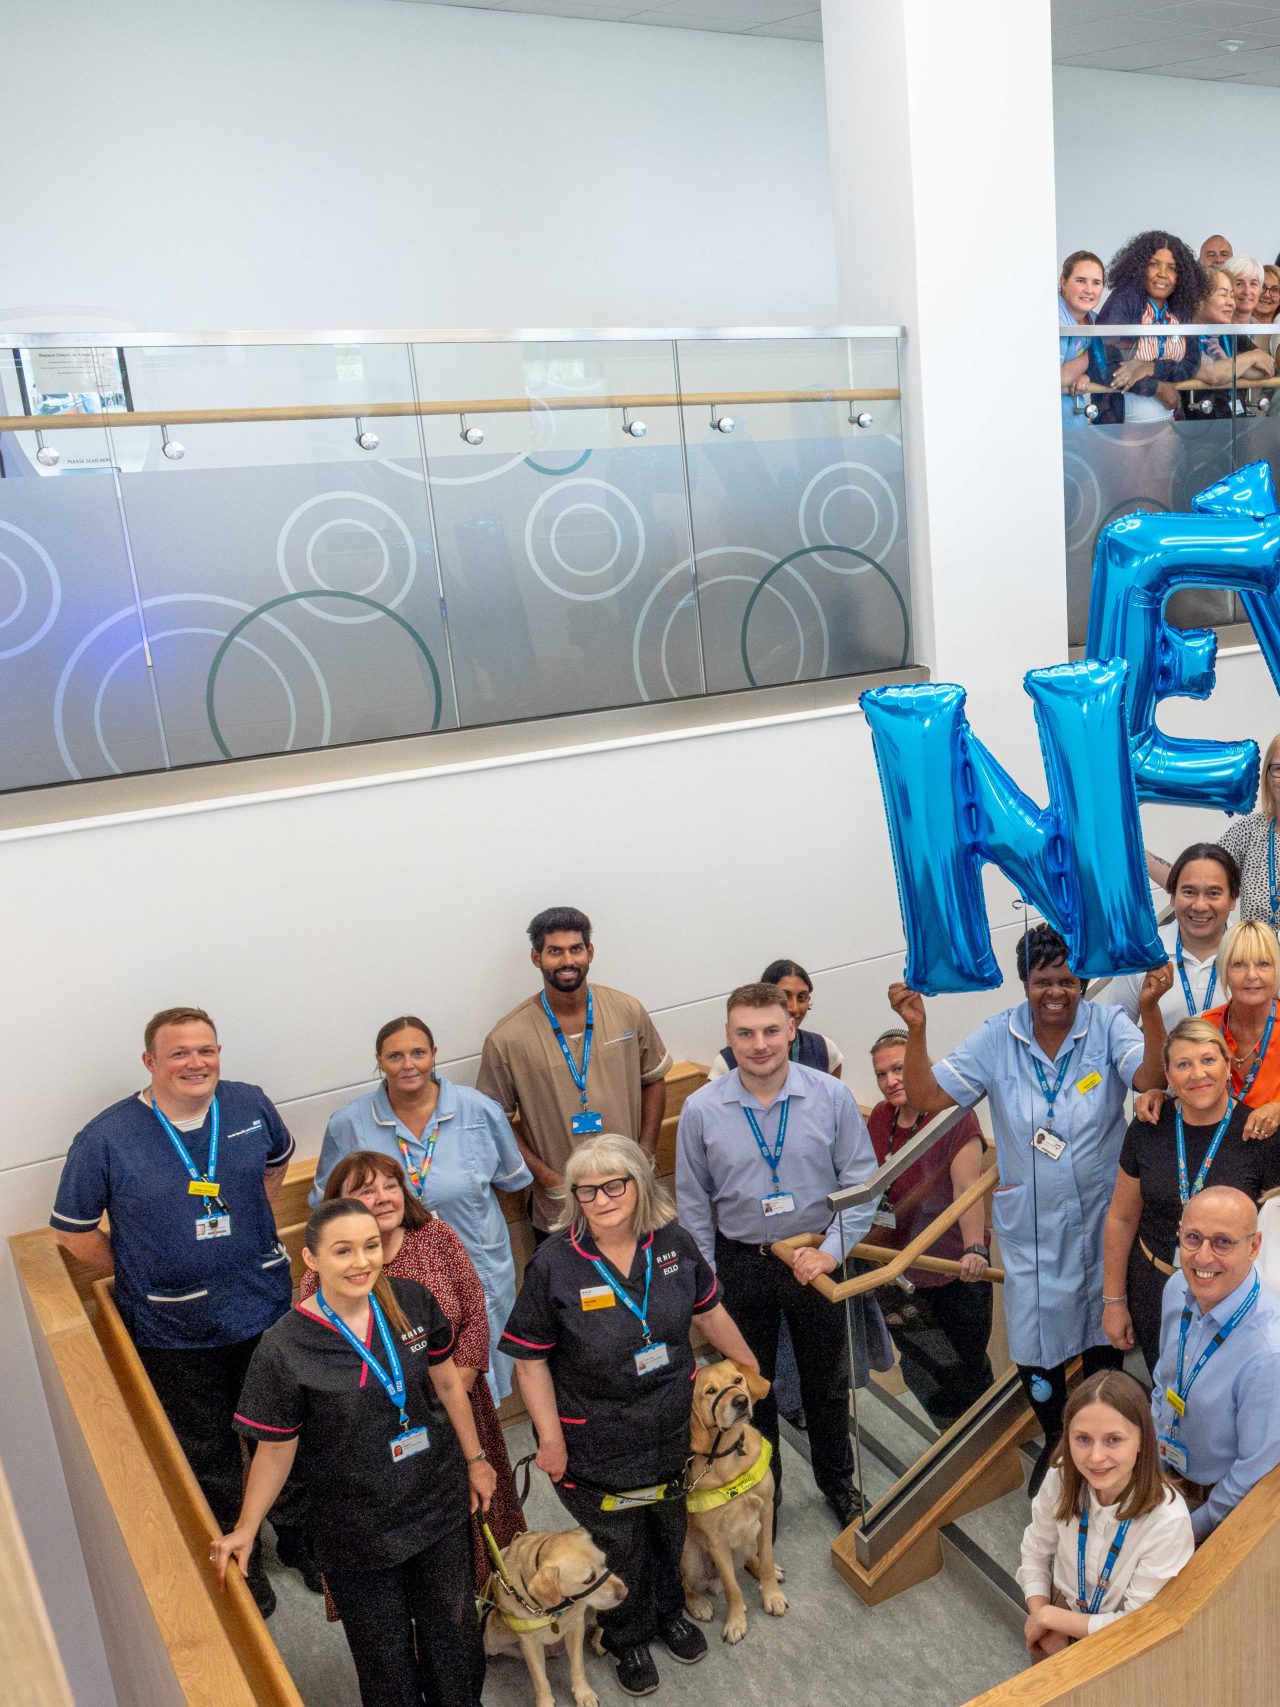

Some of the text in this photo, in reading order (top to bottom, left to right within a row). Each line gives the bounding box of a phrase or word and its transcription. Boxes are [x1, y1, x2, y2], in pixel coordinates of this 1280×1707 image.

[656, 1250, 677, 1264] RNIB
[663, 1264, 679, 1275] ECLO
[401, 1325, 425, 1341] RNIB
[410, 1340, 428, 1353] ECLO
